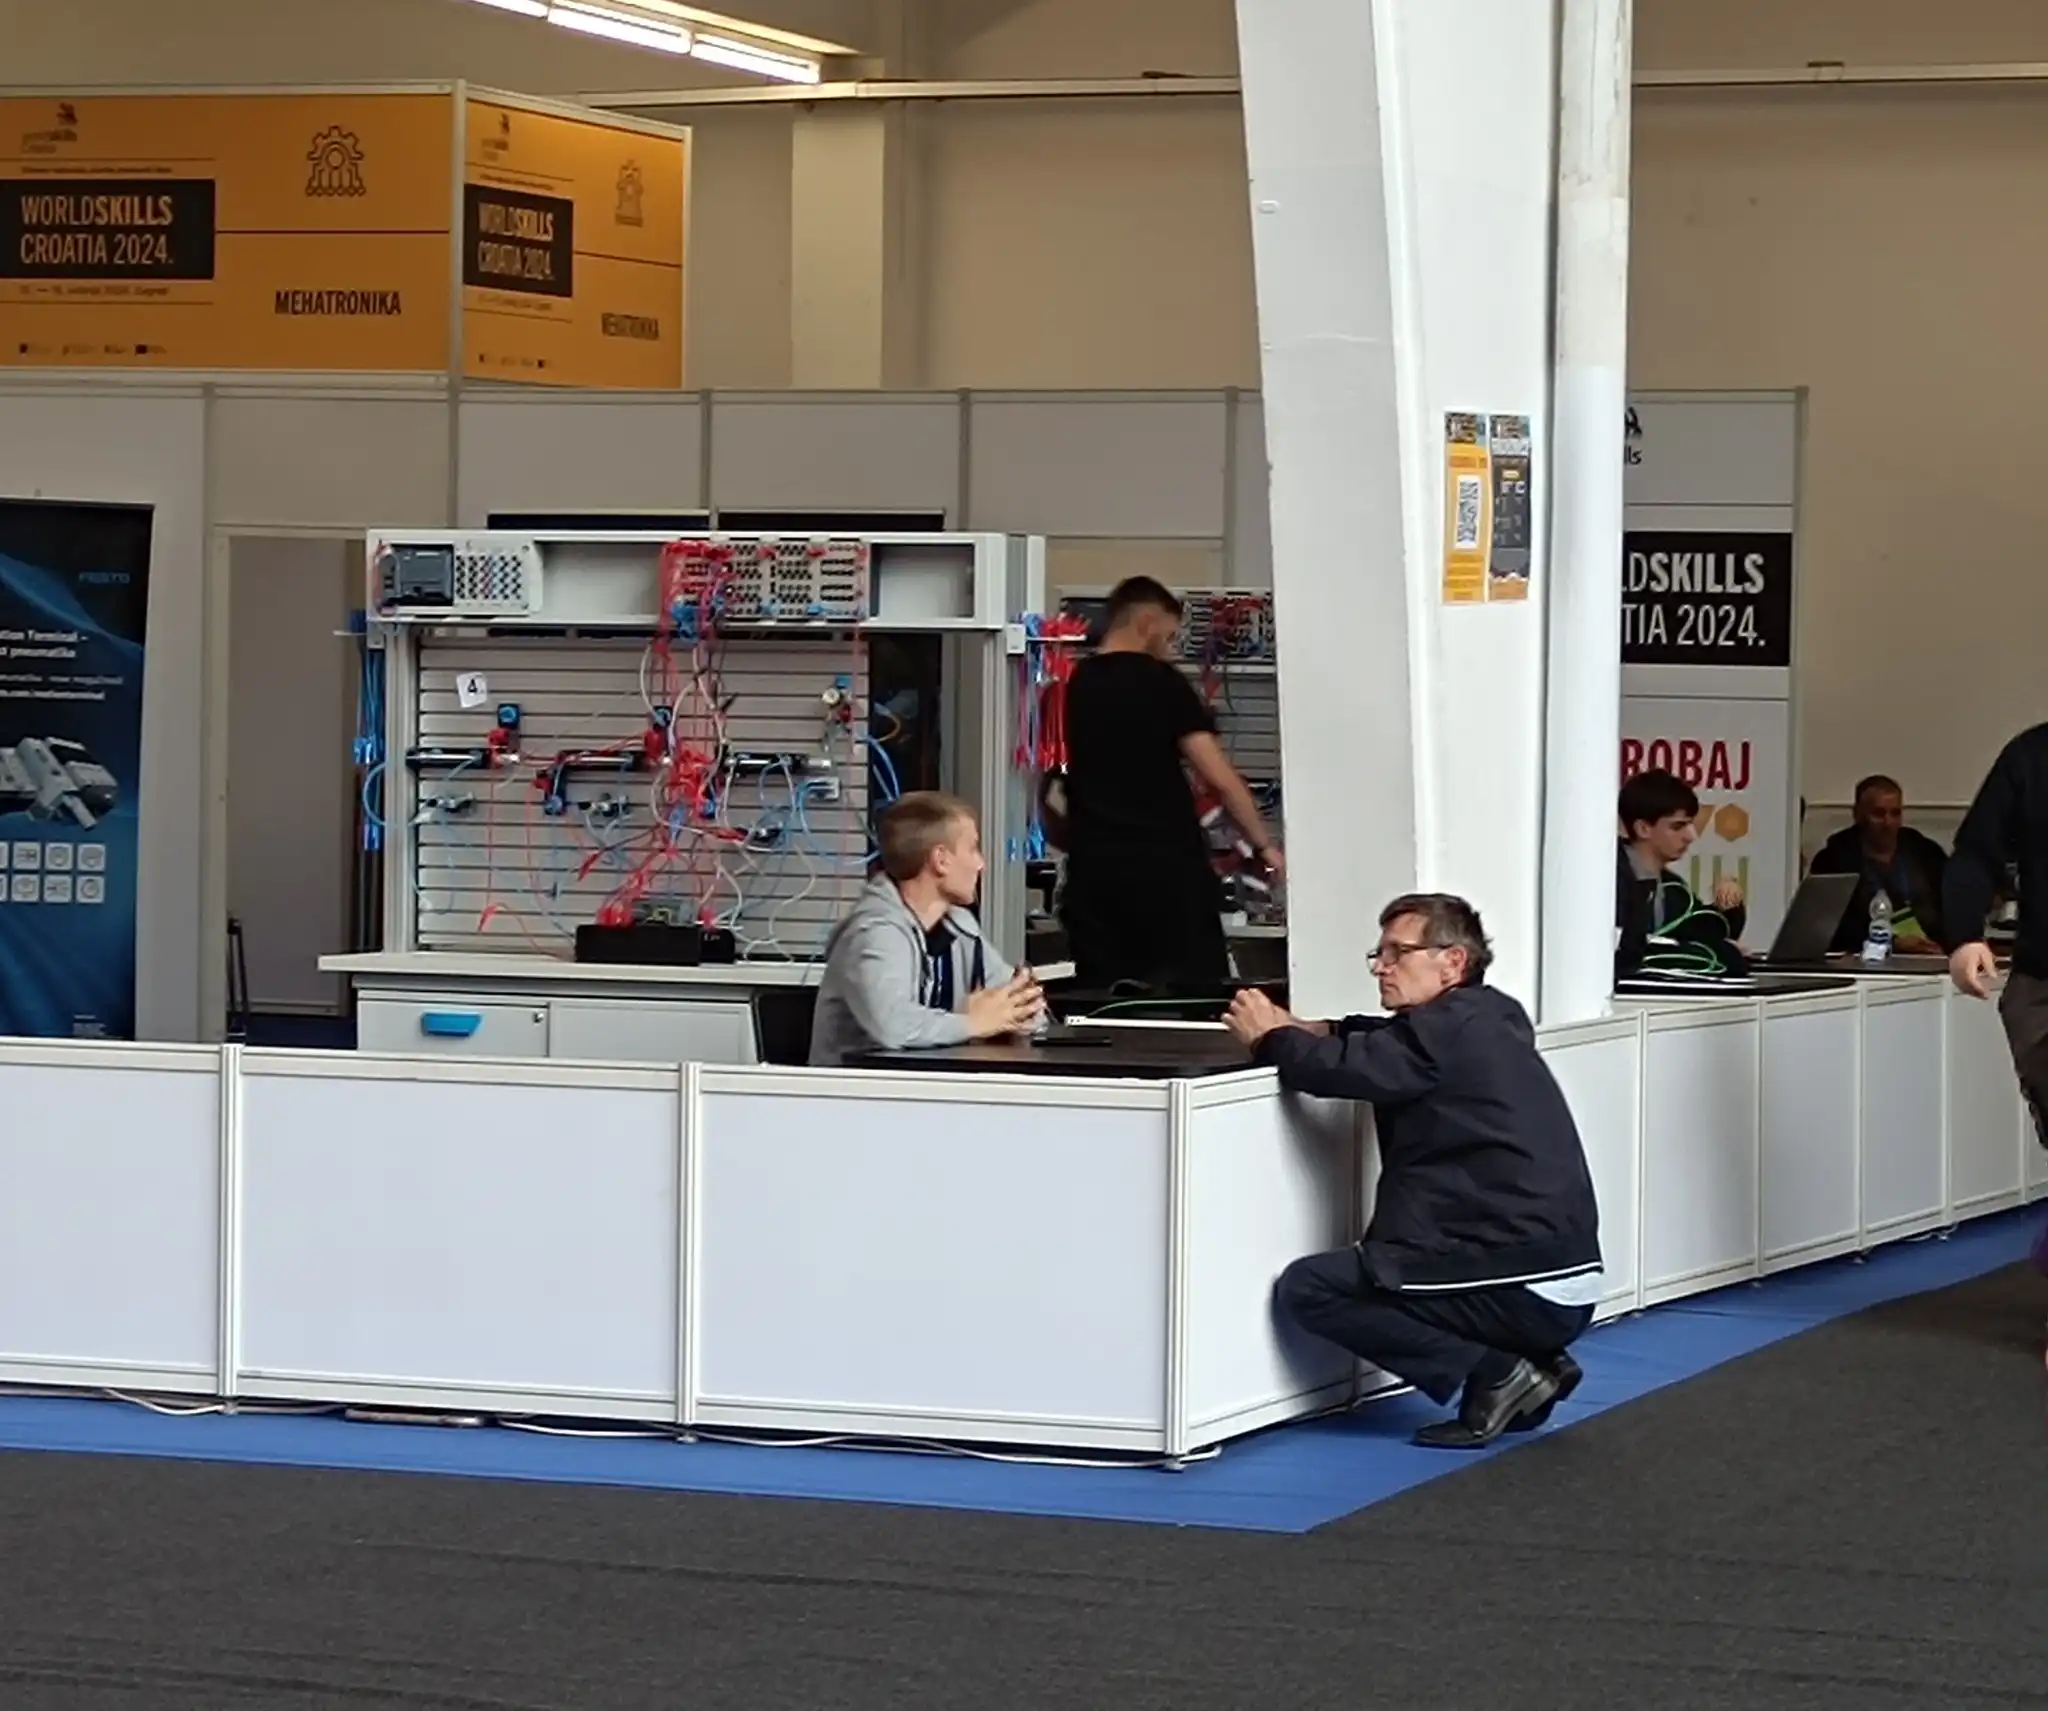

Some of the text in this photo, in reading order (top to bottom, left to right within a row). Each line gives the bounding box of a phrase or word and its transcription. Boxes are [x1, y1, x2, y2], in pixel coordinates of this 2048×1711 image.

[20, 195, 174, 226] WORLDSKILLS
[479, 203, 555, 241] WORLDSKILLS
[20, 233, 174, 265] CROATIA 2024.
[274, 289, 402, 316] MEHATRONIKA
[1676, 603, 1766, 647] 2024.
